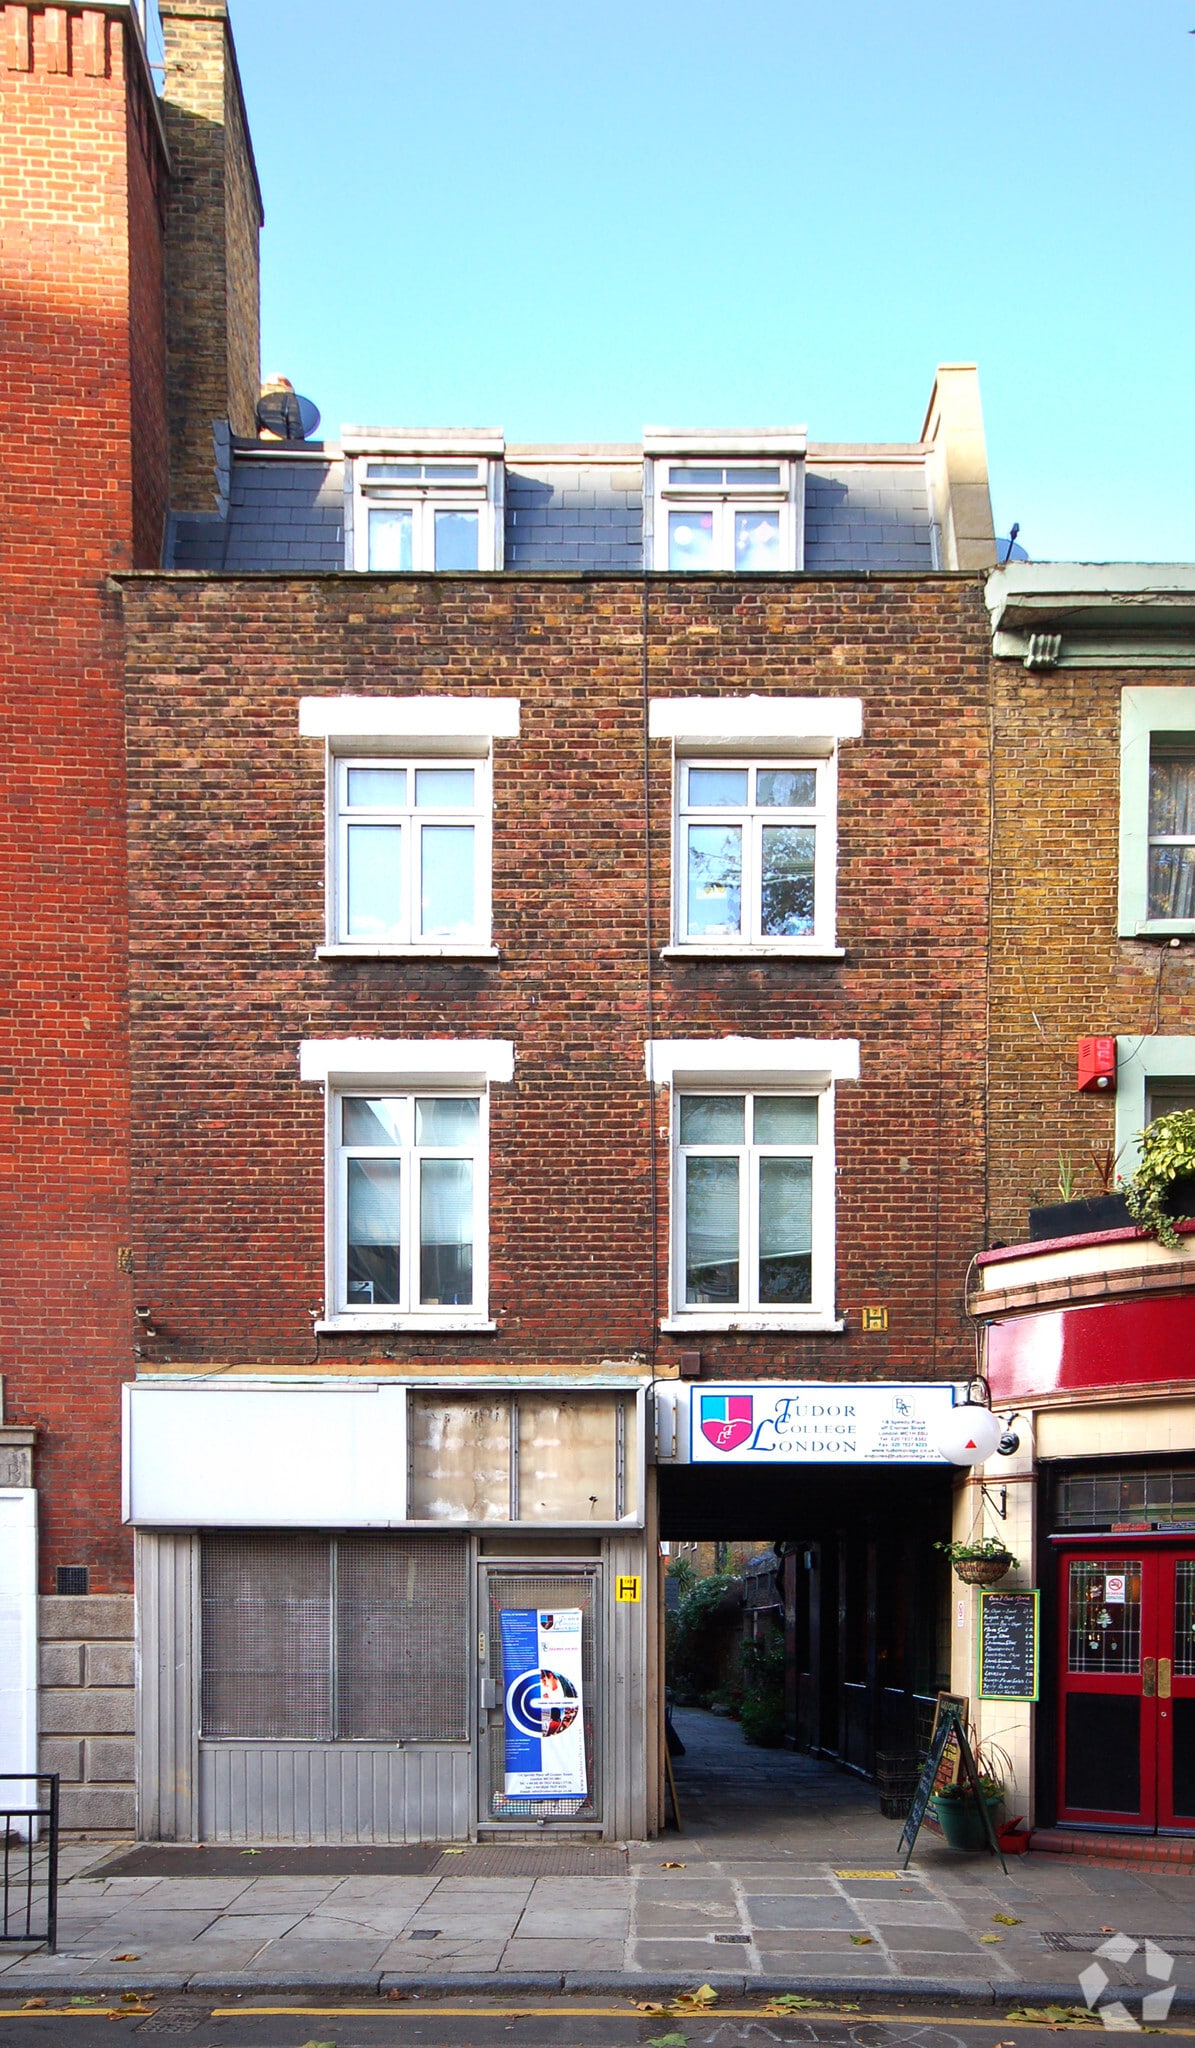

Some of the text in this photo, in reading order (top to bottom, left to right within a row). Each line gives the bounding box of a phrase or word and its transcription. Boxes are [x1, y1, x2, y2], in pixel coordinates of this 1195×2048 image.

[866, 1308, 885, 1328] H
[775, 1396, 856, 1423] TUDOR
[774, 1413, 856, 1434] COLLEGE
[747, 1419, 857, 1452] LONDON
[620, 1578, 637, 1599] H
